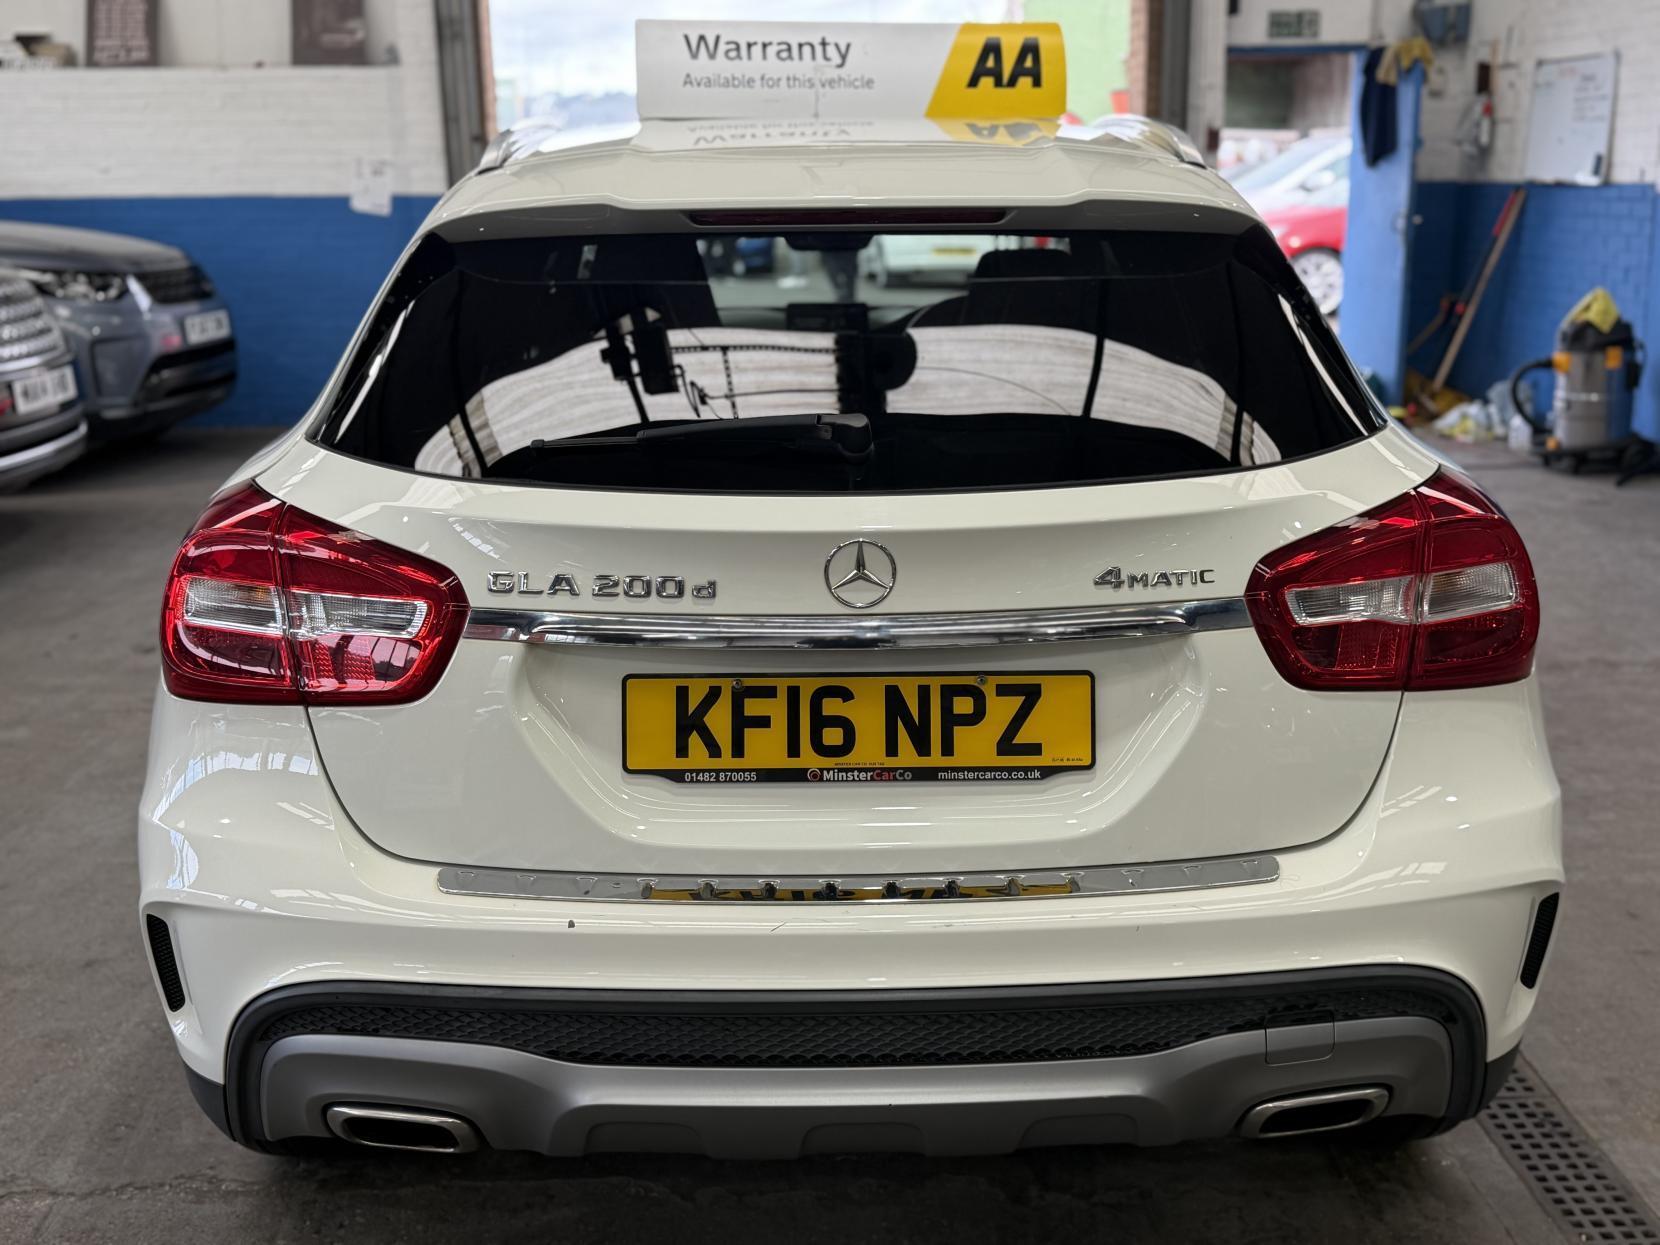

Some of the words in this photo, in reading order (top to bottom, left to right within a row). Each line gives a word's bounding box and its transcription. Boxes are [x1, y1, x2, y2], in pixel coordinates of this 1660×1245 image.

[683, 33, 851, 68] Warranty
[966, 37, 1042, 89] AA
[682, 73, 756, 89] Available
[760, 73, 783, 89] for
[786, 73, 815, 89] this
[818, 74, 875, 90] vehicle
[487, 571, 580, 596] GLA
[1093, 566, 1215, 589] 4MATIC
[675, 684, 856, 759] KF16
[885, 684, 1043, 758] NPZ
[684, 772, 716, 782] 01482
[719, 772, 757, 782] 870055
[823, 768, 912, 781] MinsterCarCo
[938, 769, 1041, 781] minstercarco.co.uk
